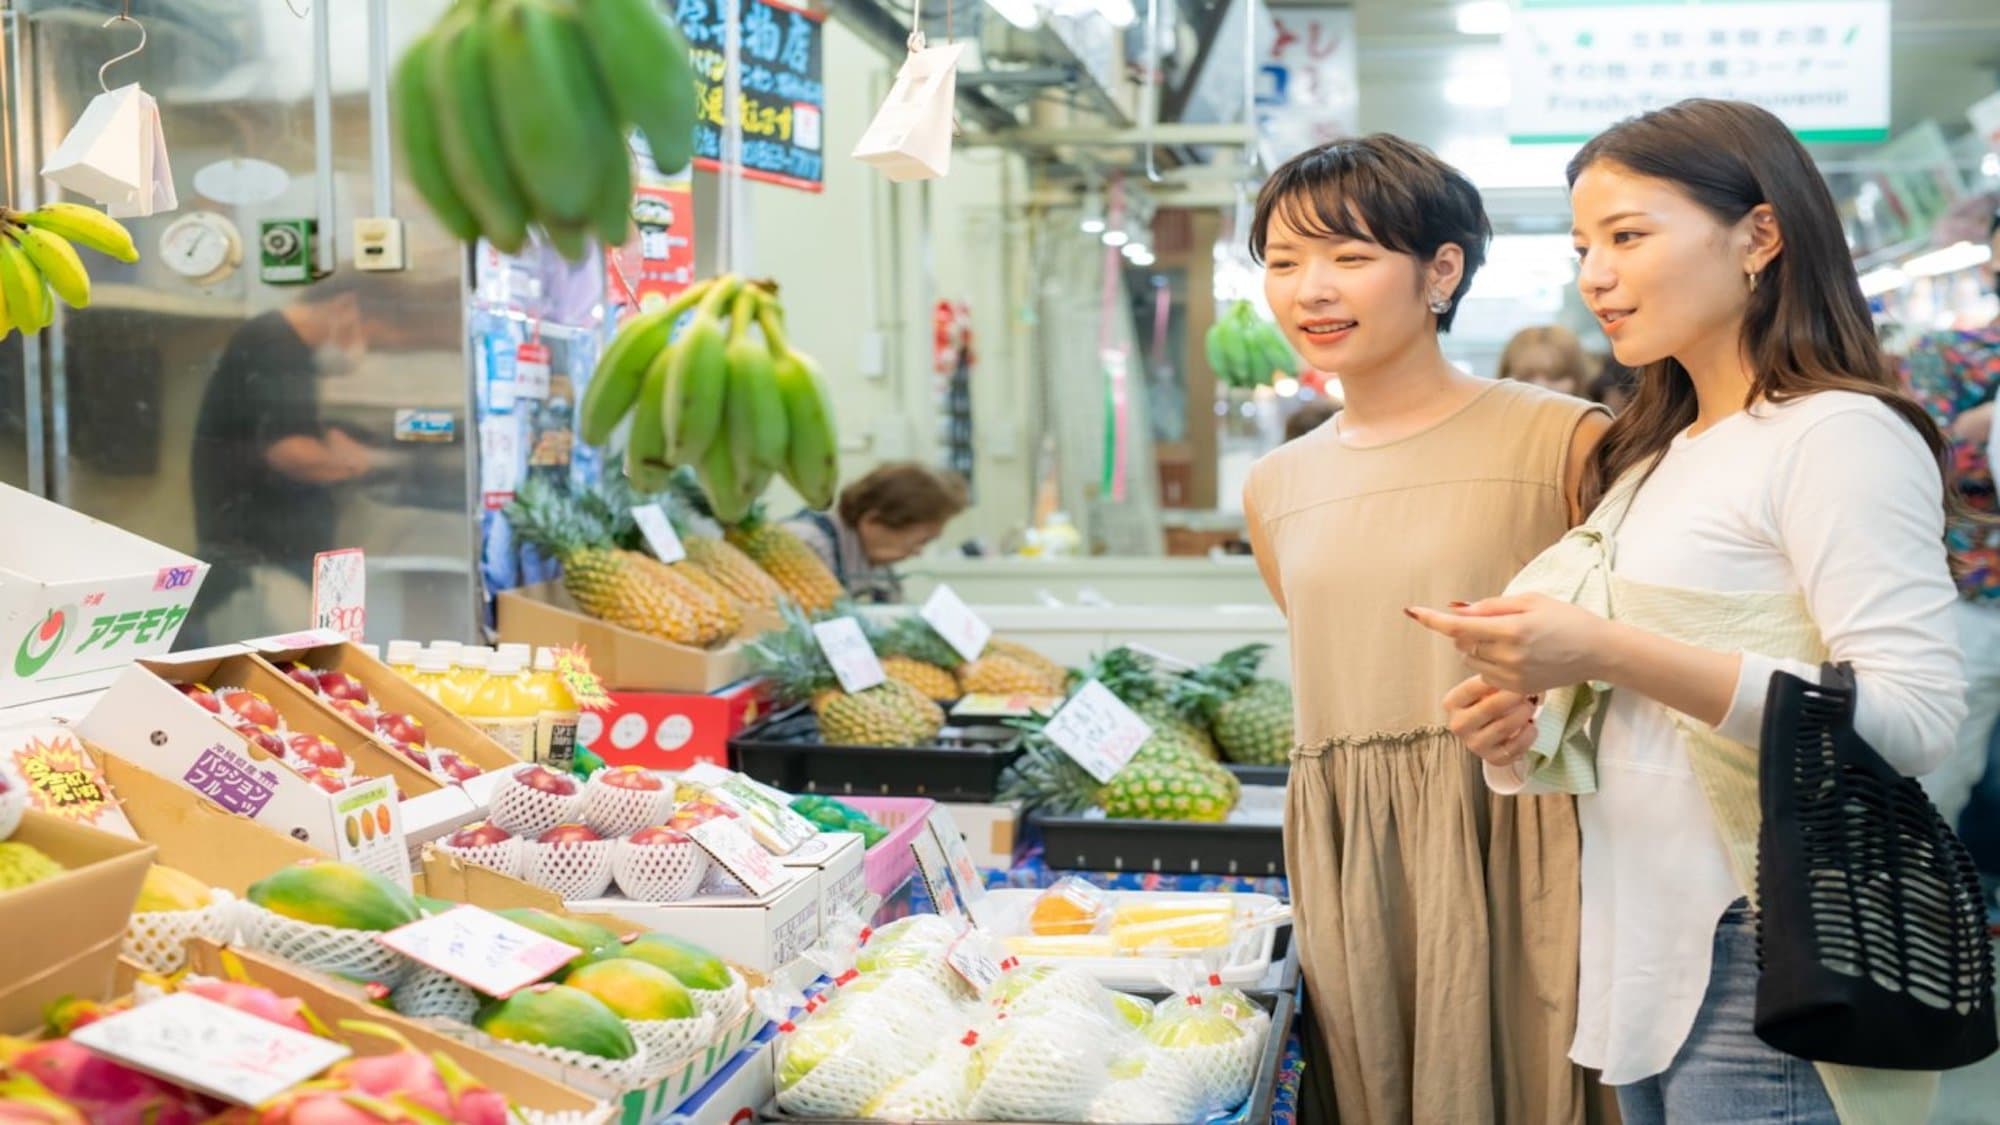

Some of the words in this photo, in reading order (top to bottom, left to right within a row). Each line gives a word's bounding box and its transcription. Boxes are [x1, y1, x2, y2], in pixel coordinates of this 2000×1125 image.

[75, 604, 188, 654] アテモヤ
[189, 767, 257, 816] フルーツ
[199, 754, 268, 802] パッション
